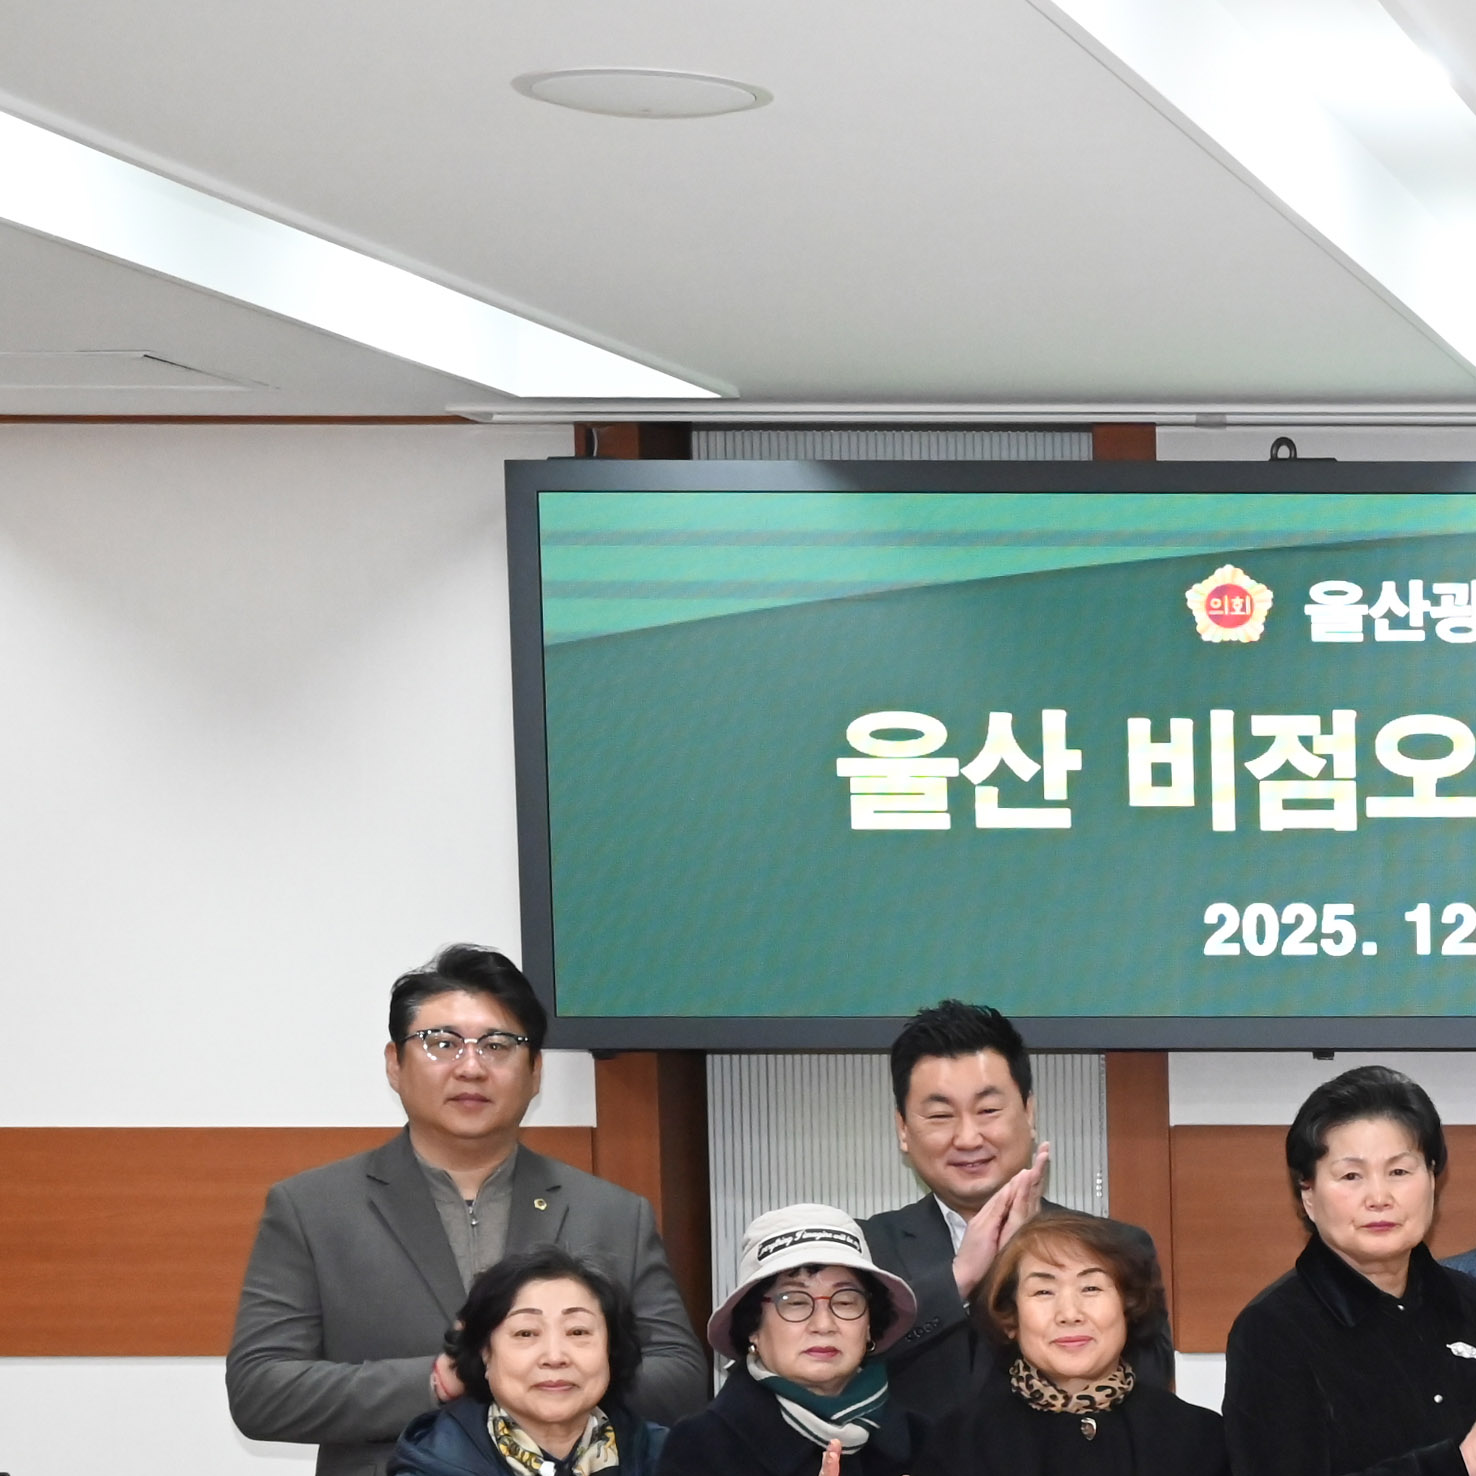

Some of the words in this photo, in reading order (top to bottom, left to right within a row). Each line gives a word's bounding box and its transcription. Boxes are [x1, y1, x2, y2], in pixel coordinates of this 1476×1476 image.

[1208, 594, 1251, 616] 의회
[836, 709, 1082, 830] 울산
[1204, 903, 1377, 957] 2025.
